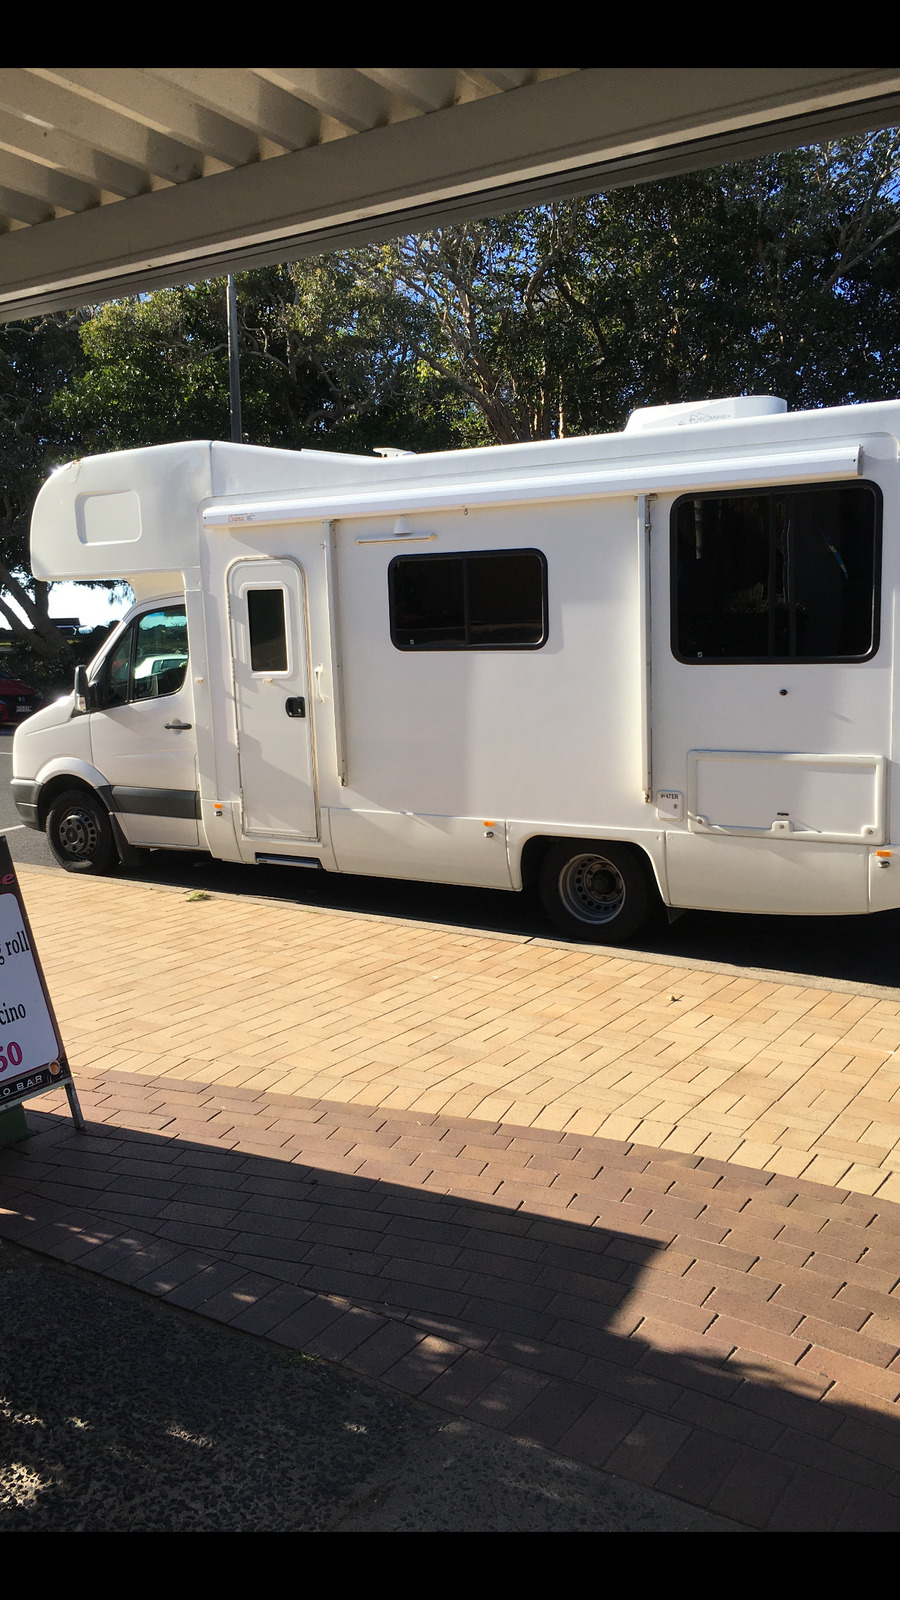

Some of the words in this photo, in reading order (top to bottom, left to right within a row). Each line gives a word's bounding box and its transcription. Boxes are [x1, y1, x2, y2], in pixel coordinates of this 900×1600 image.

[0, 873, 15, 885] e
[5, 930, 30, 956] roll
[16, 1074, 43, 1091] BAR
